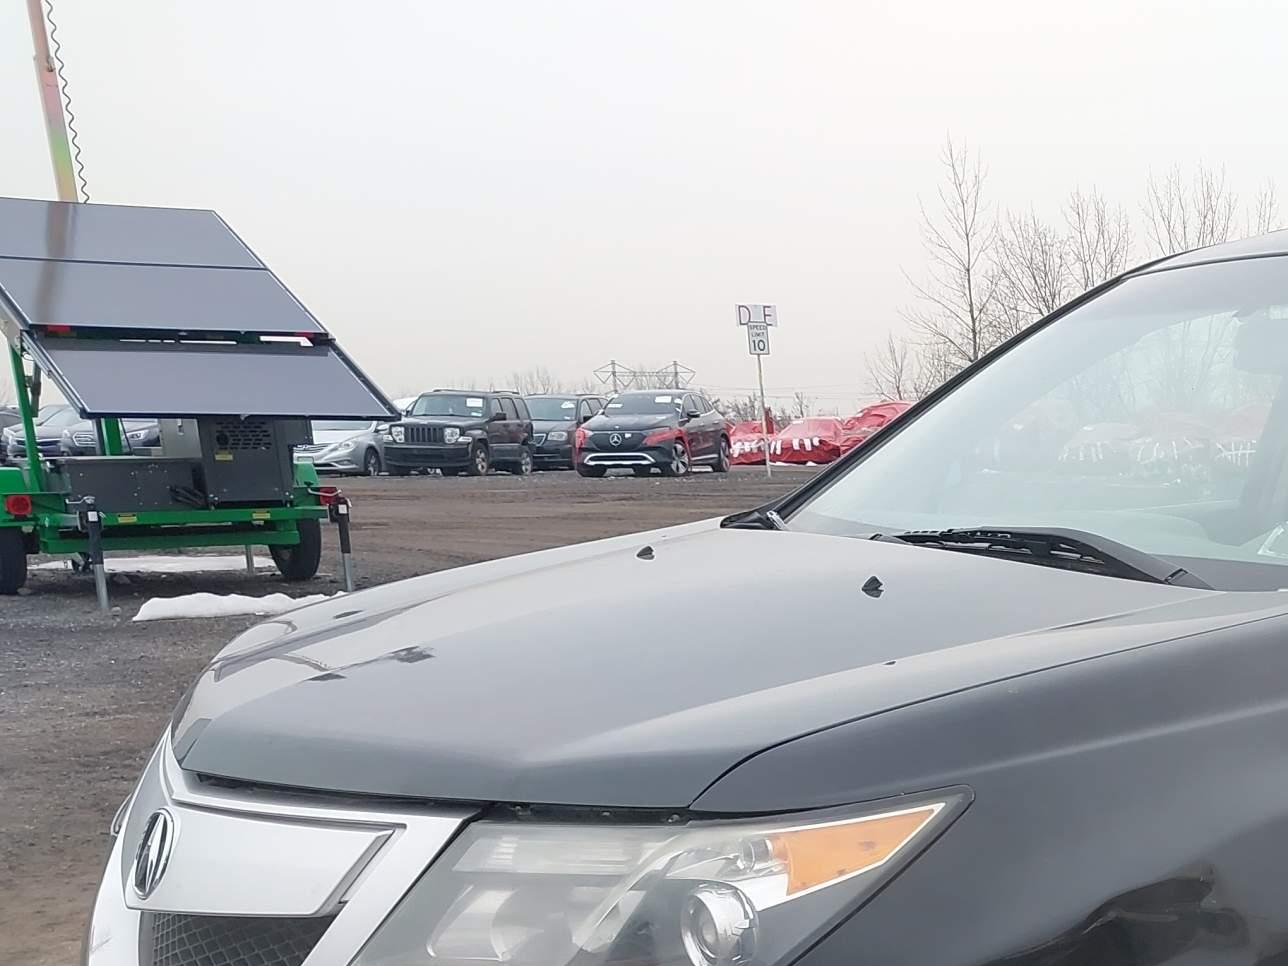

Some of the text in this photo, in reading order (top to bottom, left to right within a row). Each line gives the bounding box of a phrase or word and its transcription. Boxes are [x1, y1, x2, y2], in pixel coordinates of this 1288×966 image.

[738, 305, 773, 326] D E
[752, 339, 766, 351] 10
